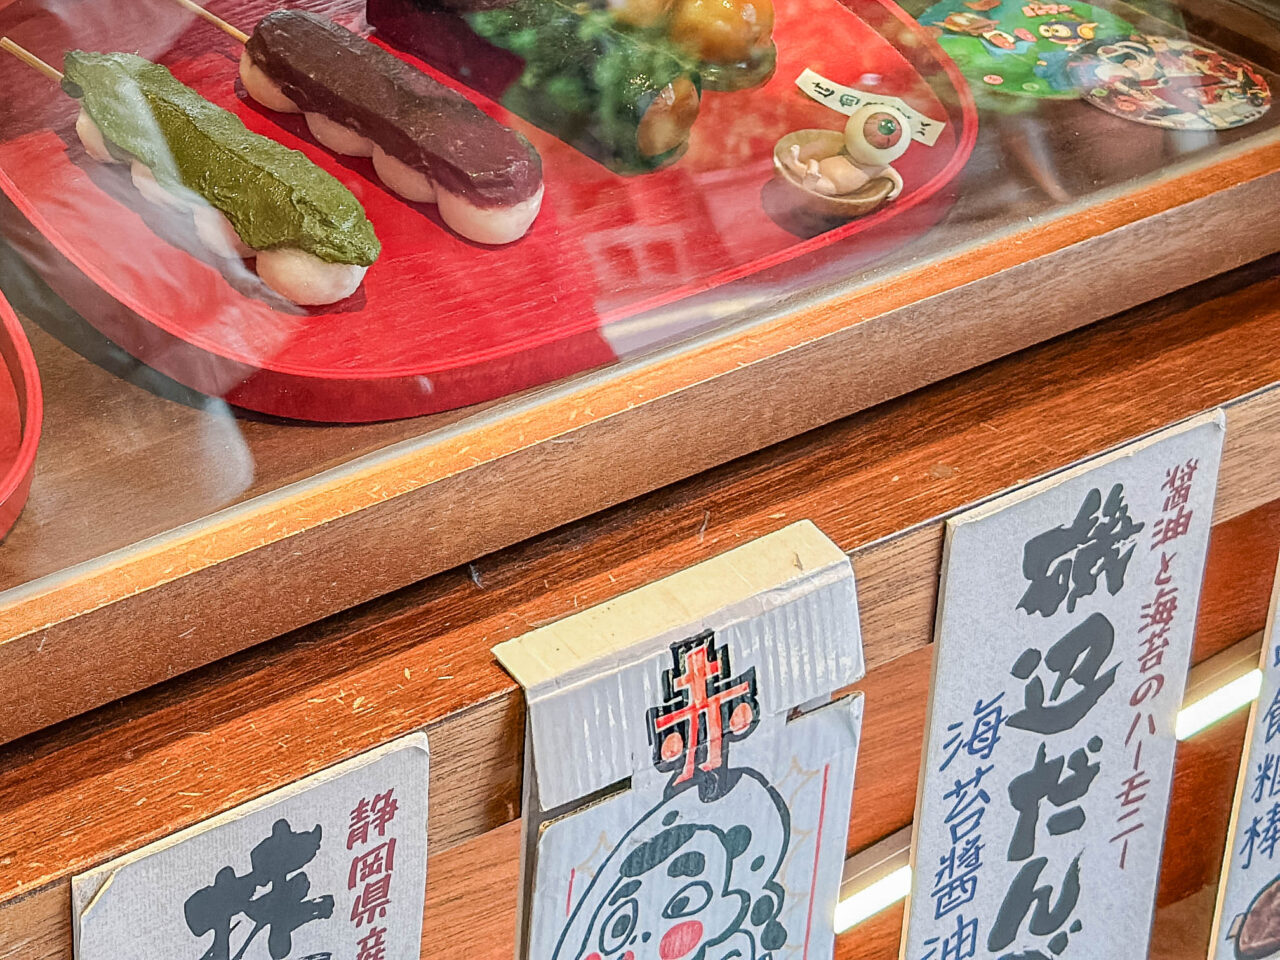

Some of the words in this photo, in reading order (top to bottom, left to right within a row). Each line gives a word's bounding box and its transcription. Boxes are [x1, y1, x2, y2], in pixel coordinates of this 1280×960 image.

[987, 483, 1145, 960] 磯辺だん
[1109, 458, 1199, 870] 醤油と海苔のハーモニー
